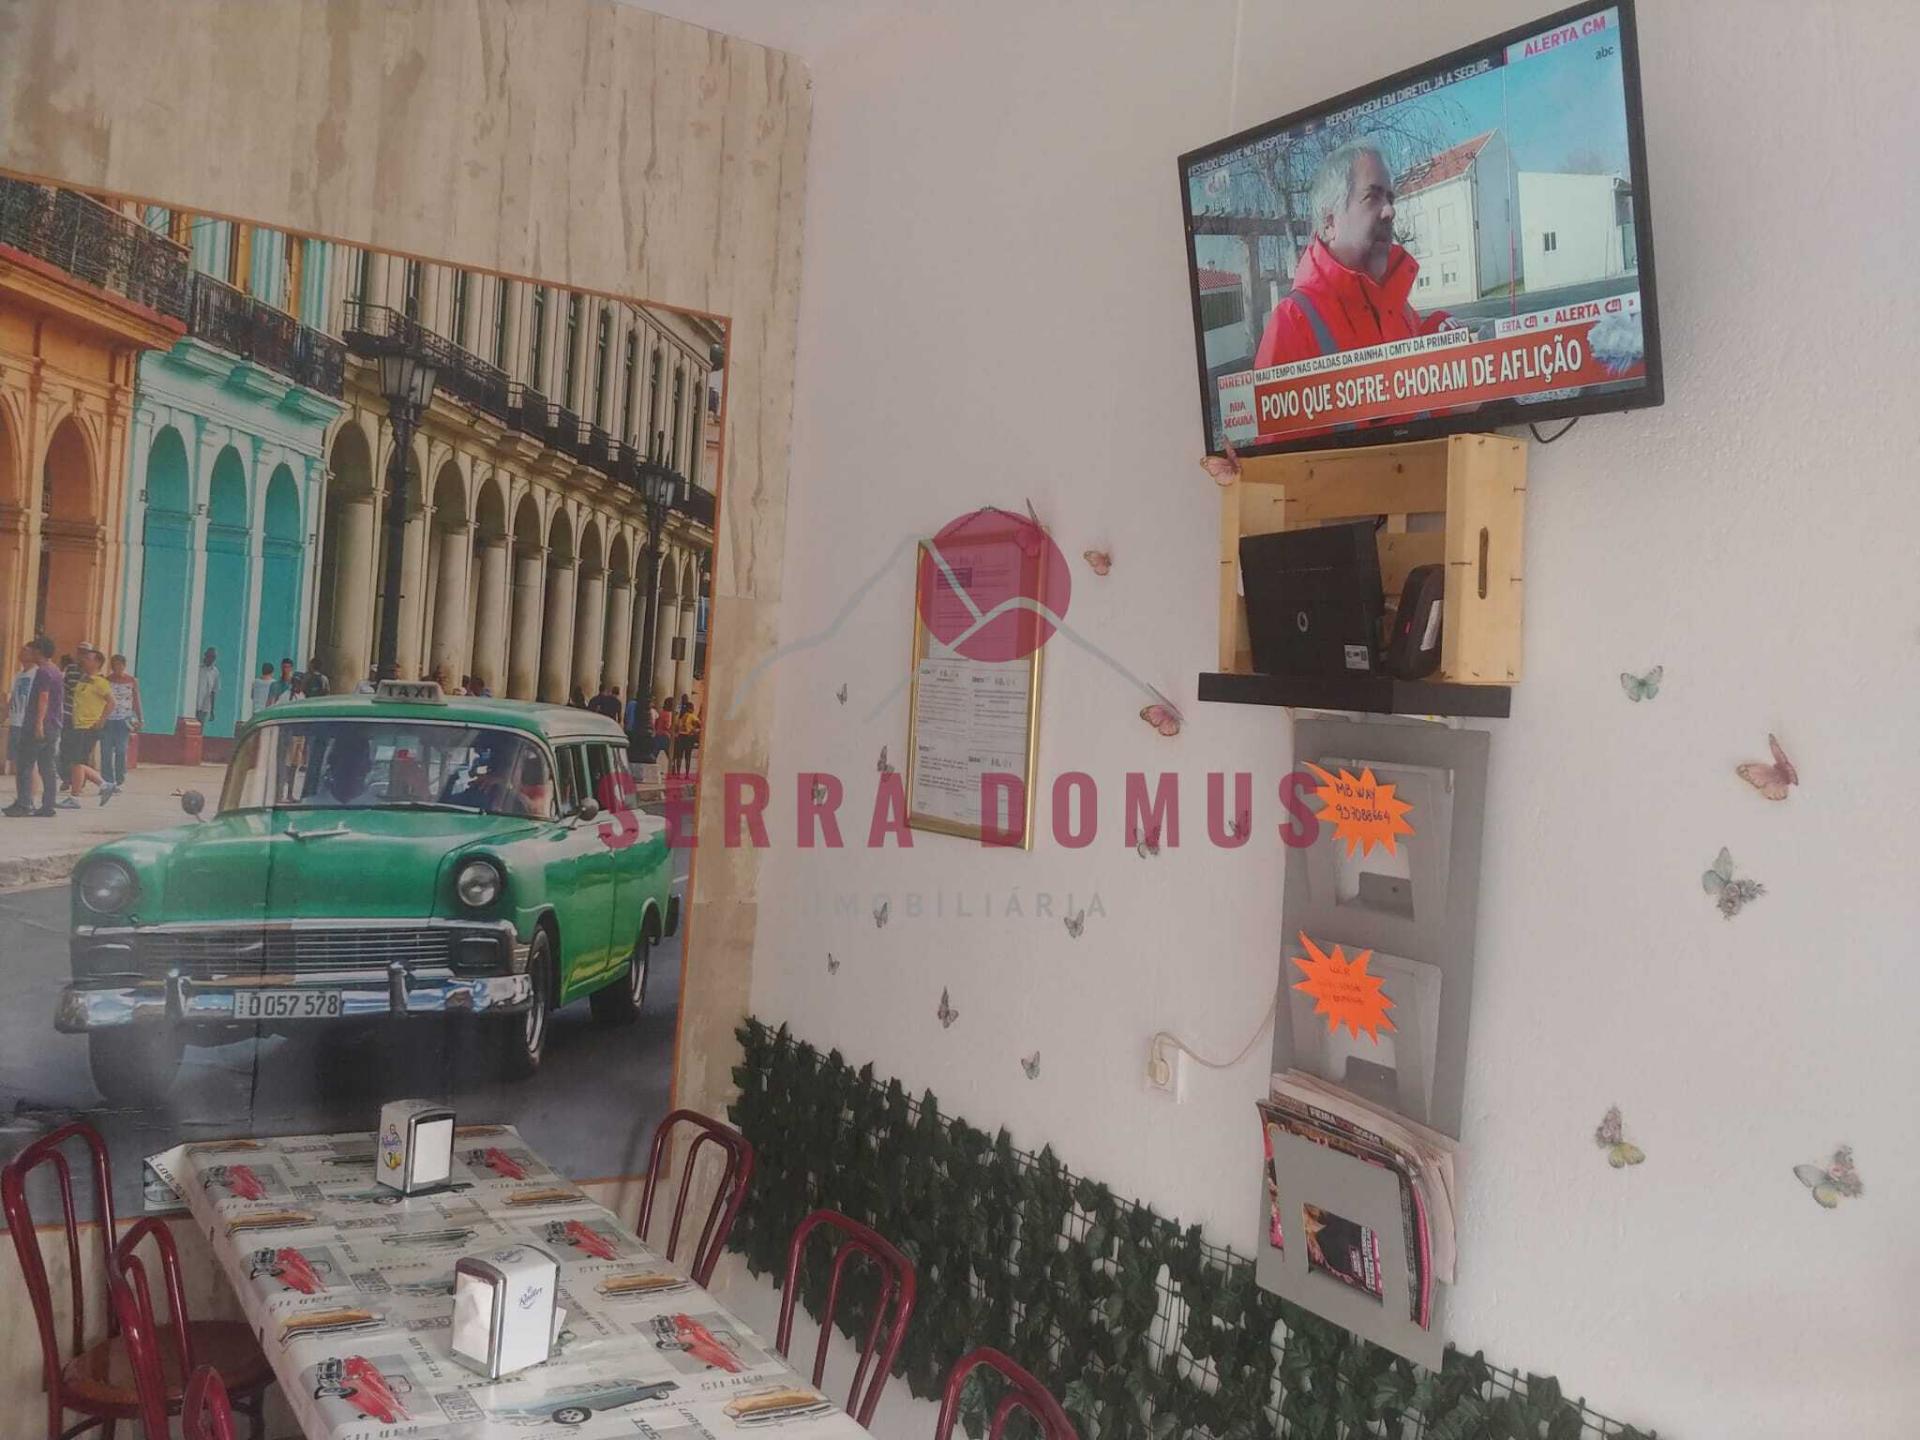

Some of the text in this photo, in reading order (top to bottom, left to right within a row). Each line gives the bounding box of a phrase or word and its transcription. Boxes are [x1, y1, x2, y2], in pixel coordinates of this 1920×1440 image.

[1524, 16, 1606, 58] ALERTA CM
[1595, 46, 1614, 60] abc
[1325, 97, 1382, 128] REPORTAGEM
[1382, 93, 1397, 107] EM
[1555, 303, 1601, 324] ALERTA
[1256, 371, 1271, 384] MAU
[1272, 365, 1296, 380] TEMPO
[1296, 363, 1312, 377] NAS
[1313, 357, 1341, 370] CALDAS
[1342, 354, 1353, 365] DA
[1354, 349, 1384, 362] RAINHA
[1389, 342, 1412, 356] CMTV
[1426, 330, 1468, 348] PRIMEIRO
[1218, 373, 1252, 390] DIRETO
[1261, 334, 1582, 421] POVO QUE SOFRE: CHORAM DE AFLIÇÃO
[383, 684, 432, 699] TAXI
[1335, 781, 1353, 798] MB
[264, 995, 300, 1016] 057
[304, 994, 339, 1016] 578
